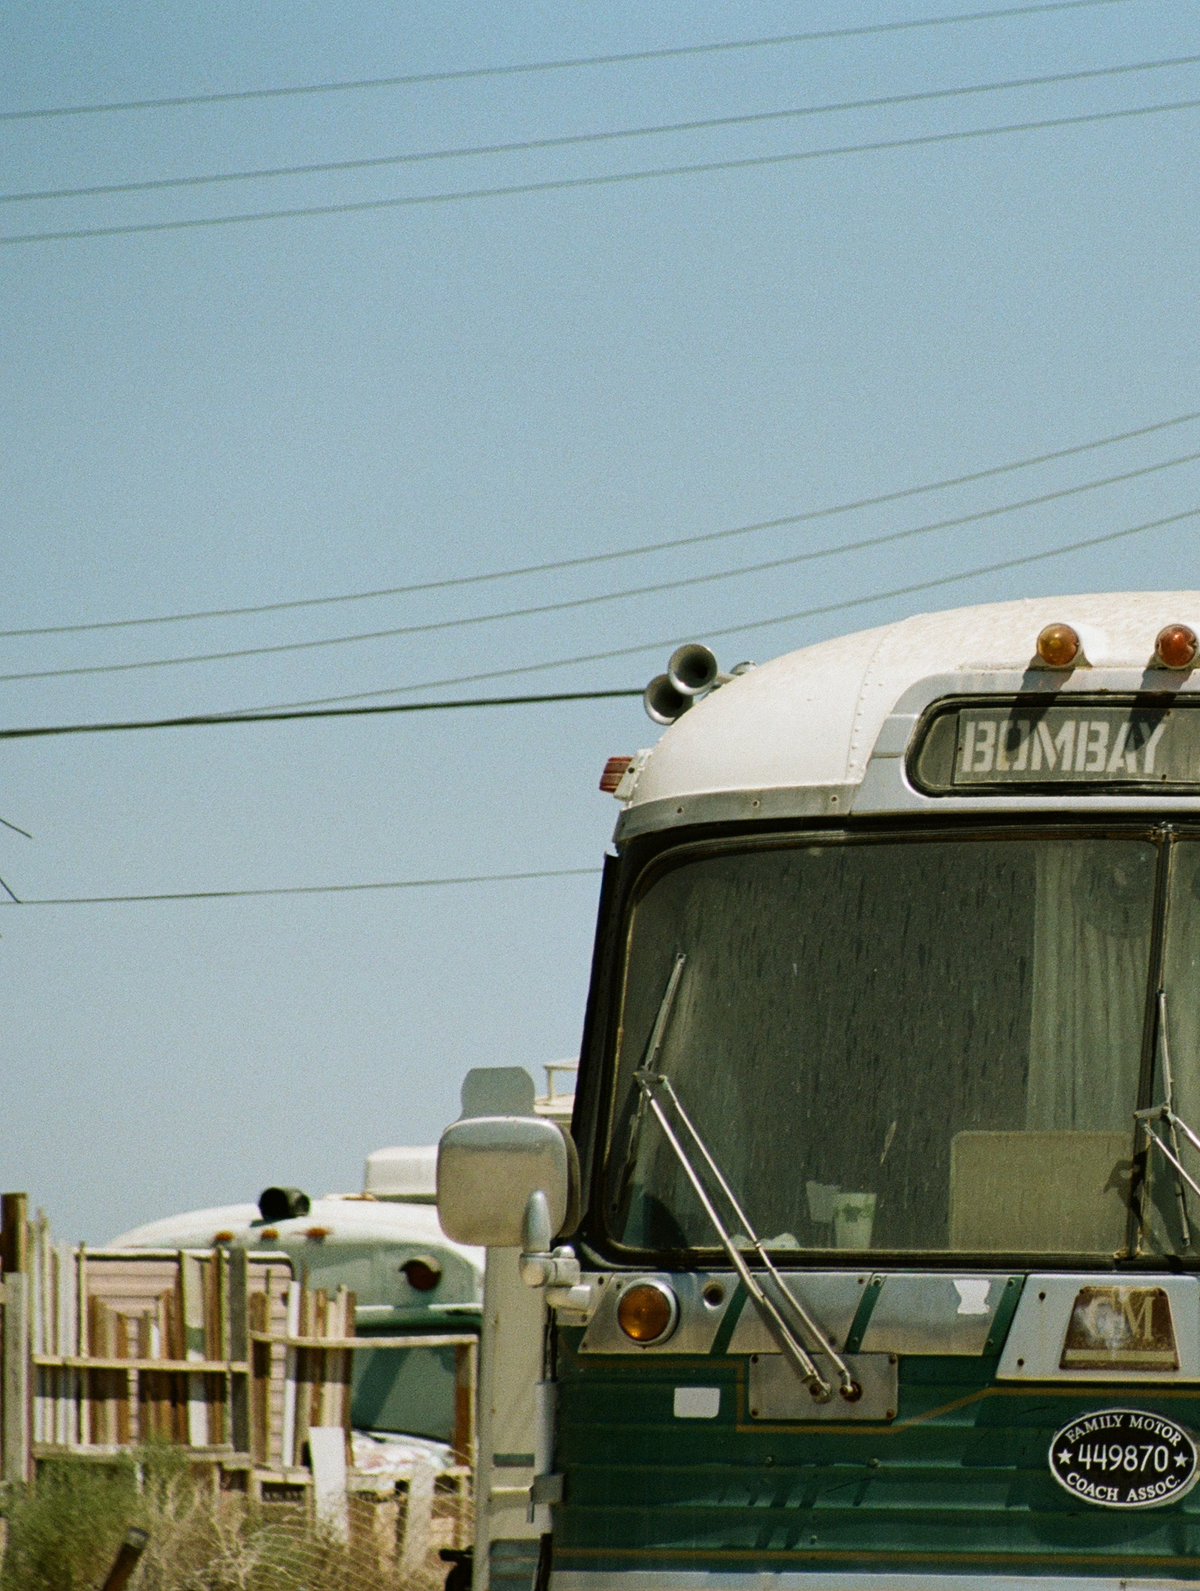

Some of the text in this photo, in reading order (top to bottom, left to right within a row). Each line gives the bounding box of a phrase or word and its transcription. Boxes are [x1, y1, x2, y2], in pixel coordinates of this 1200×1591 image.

[962, 720, 1169, 775] BOMBAY
[1066, 1415, 1182, 1446] FAMILY MOTOR
[1078, 1444, 1169, 1472] 449870
[1066, 1472, 1181, 1502] COACH ASSOC.
